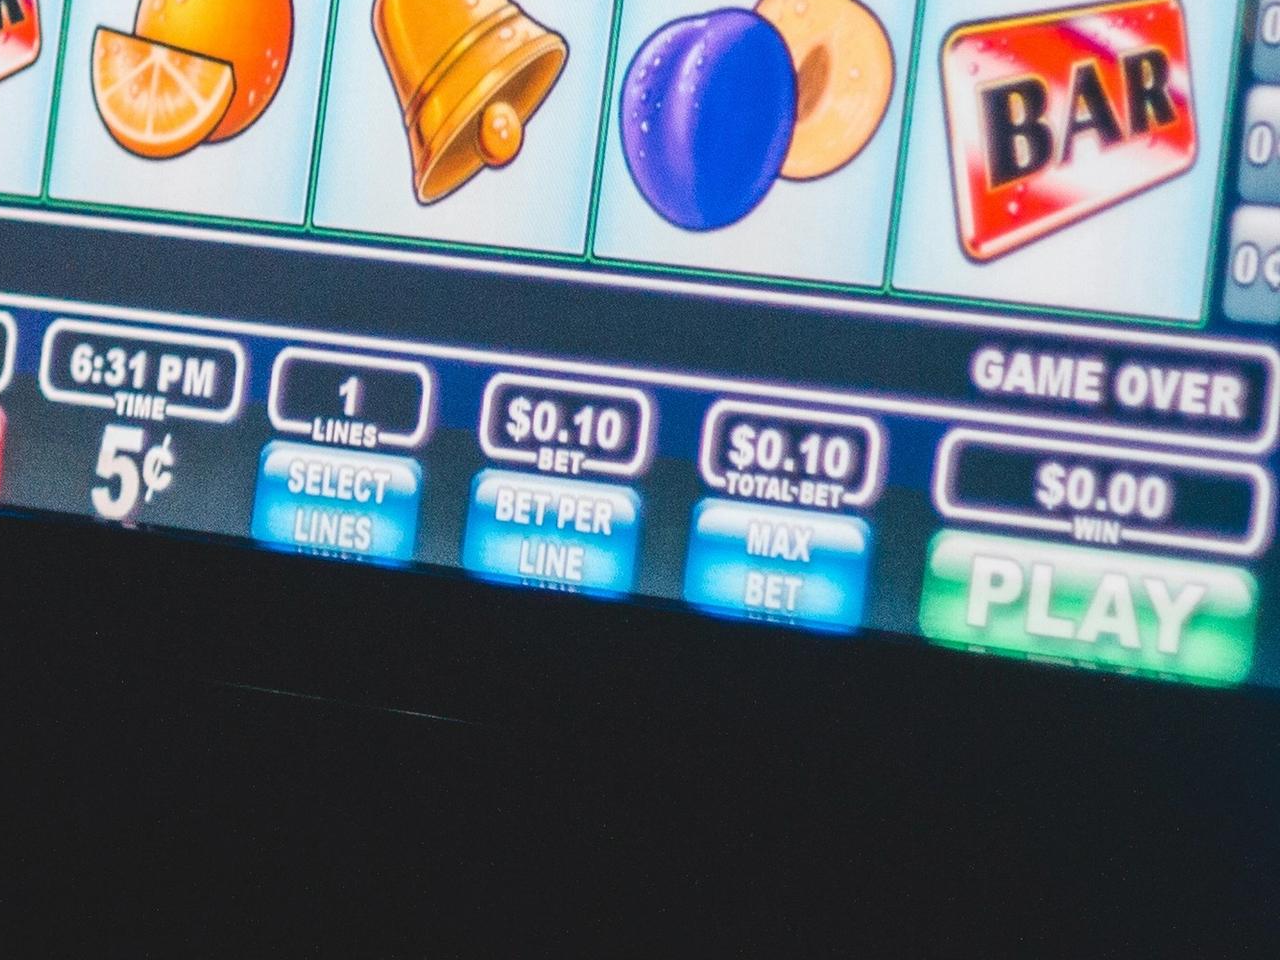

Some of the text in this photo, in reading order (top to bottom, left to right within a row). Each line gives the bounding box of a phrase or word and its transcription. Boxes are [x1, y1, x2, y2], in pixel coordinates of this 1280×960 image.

[980, 48, 1177, 189] BAR
[69, 343, 216, 398] 6:31 PM
[972, 349, 1242, 419] GAME OVER
[114, 392, 167, 421] TIME
[338, 376, 362, 416] 1
[311, 417, 378, 448] LINES
[505, 396, 623, 451] $0.10
[90, 424, 176, 520] 5¢
[537, 447, 585, 476] BET
[727, 424, 851, 479] $0.10
[287, 459, 391, 505] SELECT
[1036, 461, 1168, 520] $0.00
[293, 509, 374, 552] LINES
[494, 486, 614, 537] BET PER
[1072, 517, 1121, 544] WIN
[518, 539, 587, 583] LINE
[746, 522, 816, 565] MAX
[744, 571, 805, 612] BET
[965, 554, 1207, 655] PLAY
